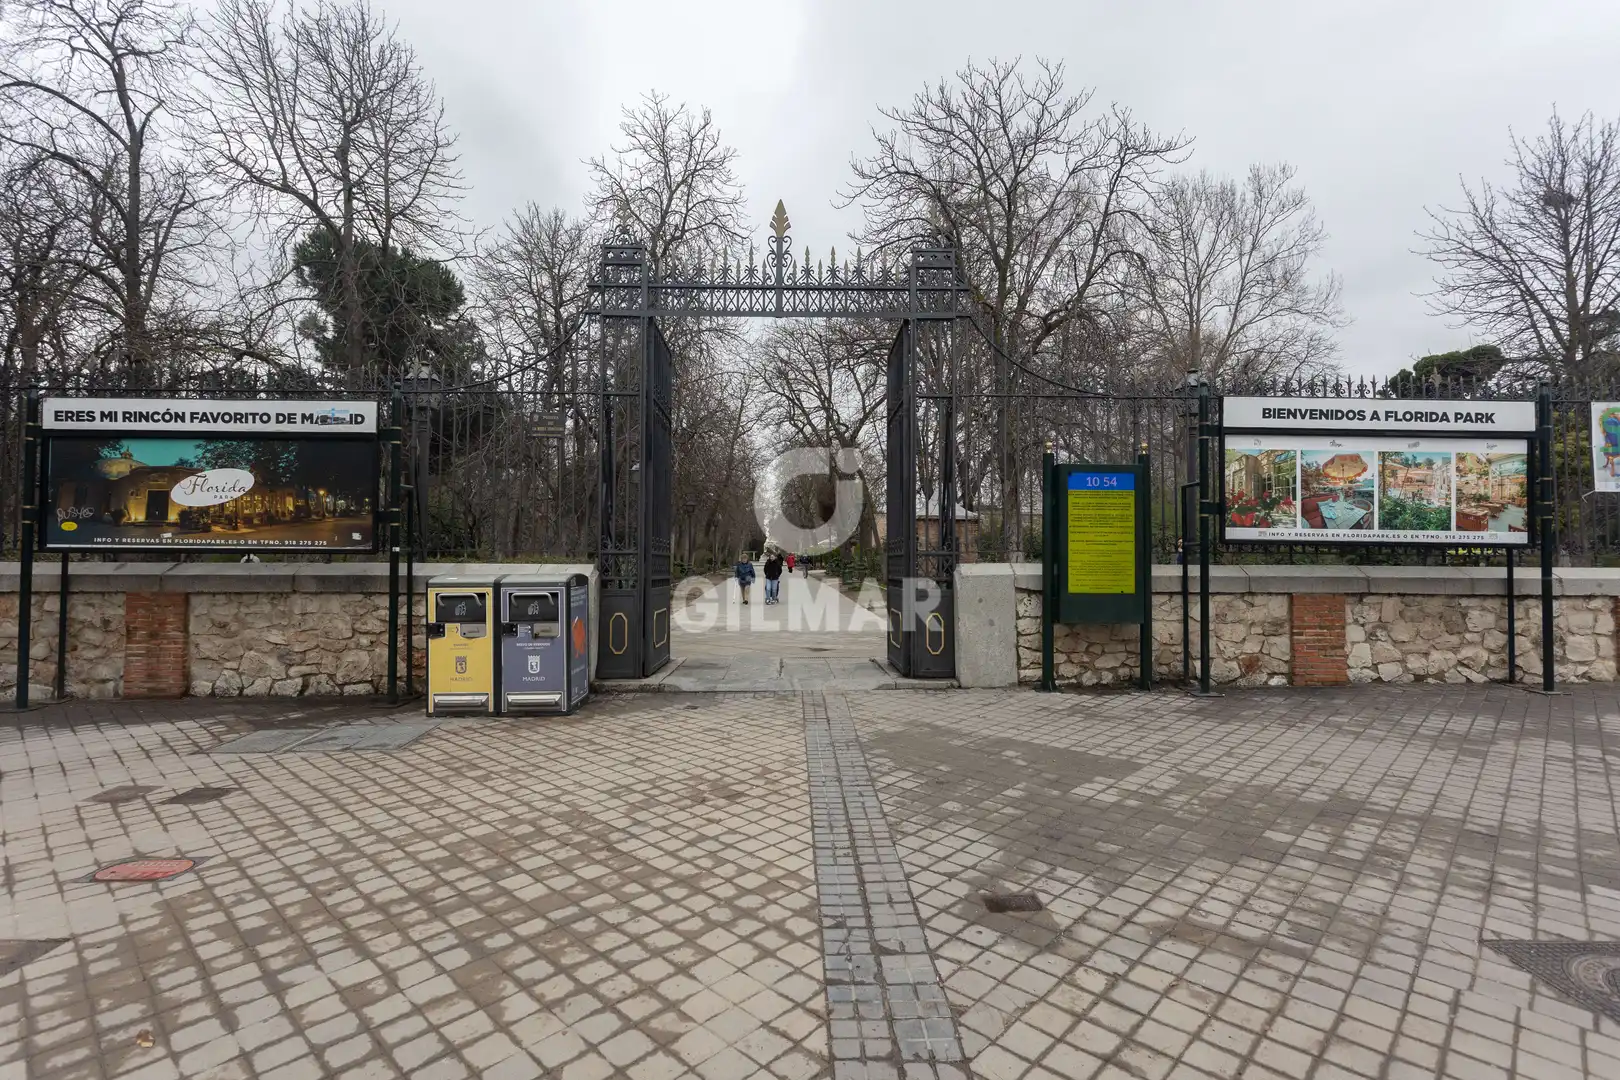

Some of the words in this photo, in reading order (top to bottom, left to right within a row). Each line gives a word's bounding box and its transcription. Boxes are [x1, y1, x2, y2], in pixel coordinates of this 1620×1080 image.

[54, 410, 96, 423] ERES
[100, 410, 118, 423] MI
[122, 408, 186, 423] RINCÓN
[190, 411, 272, 425] FAVORITO
[275, 412, 297, 425] DE
[1262, 407, 1366, 421] BIENVENIDOS
[1369, 410, 1381, 422] A
[1385, 410, 1451, 423] FLORIDA
[1454, 412, 1496, 424] PARK
[179, 473, 246, 495] Florida
[1086, 476, 1100, 487] 10
[1103, 476, 1117, 487] 54
